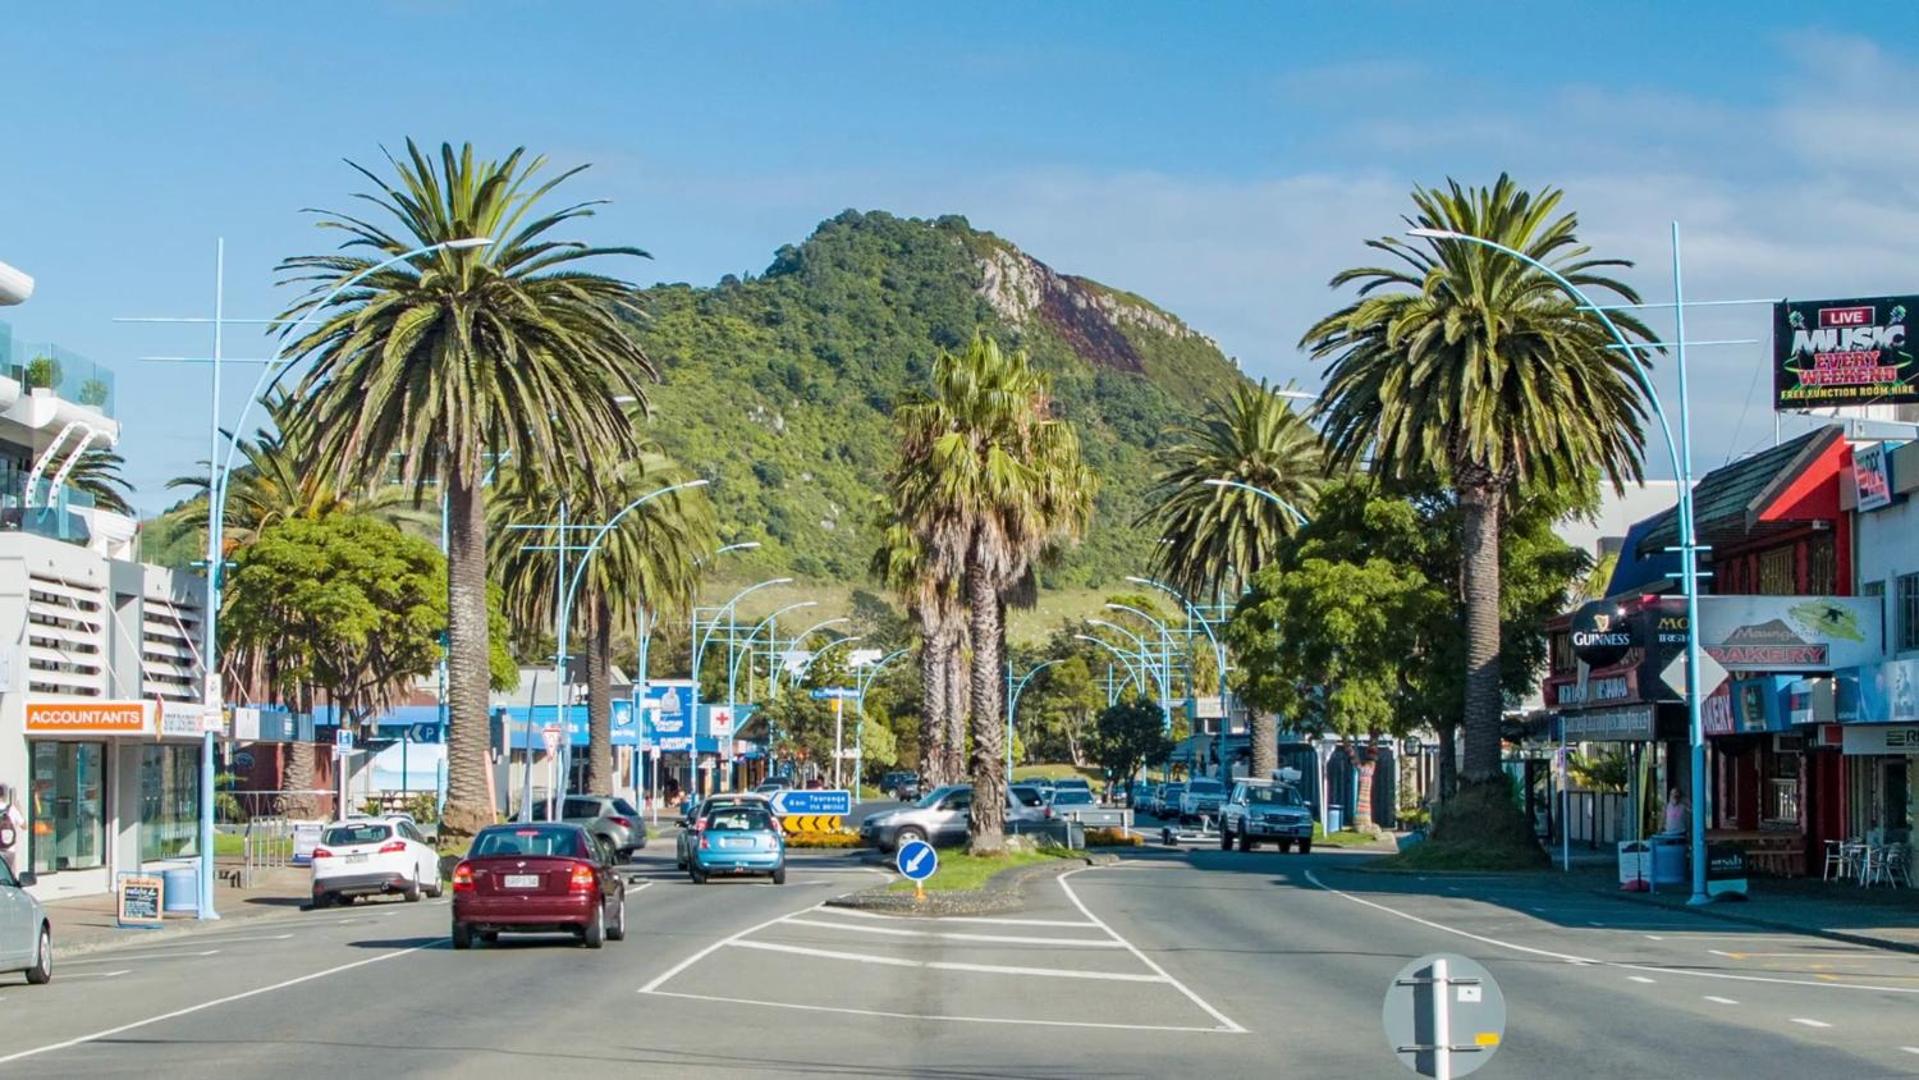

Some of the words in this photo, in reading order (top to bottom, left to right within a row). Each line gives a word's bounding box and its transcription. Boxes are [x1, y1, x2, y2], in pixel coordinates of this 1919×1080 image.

[1830, 311, 1864, 324] LIVE
[1791, 325, 1905, 356] MUSIC
[1814, 351, 1880, 369] EVERY
[1798, 367, 1897, 386] WEEKEND
[1781, 389, 1805, 400] FREE
[1808, 387, 1857, 398] FUNCTION
[1860, 386, 1889, 395] ROOM
[1892, 384, 1915, 393] HIRE
[1573, 631, 1630, 646] GUINNESS
[1706, 646, 1825, 662] BAKERY
[30, 710, 140, 724] ACCOUNTANTS
[426, 727, 435, 739] P
